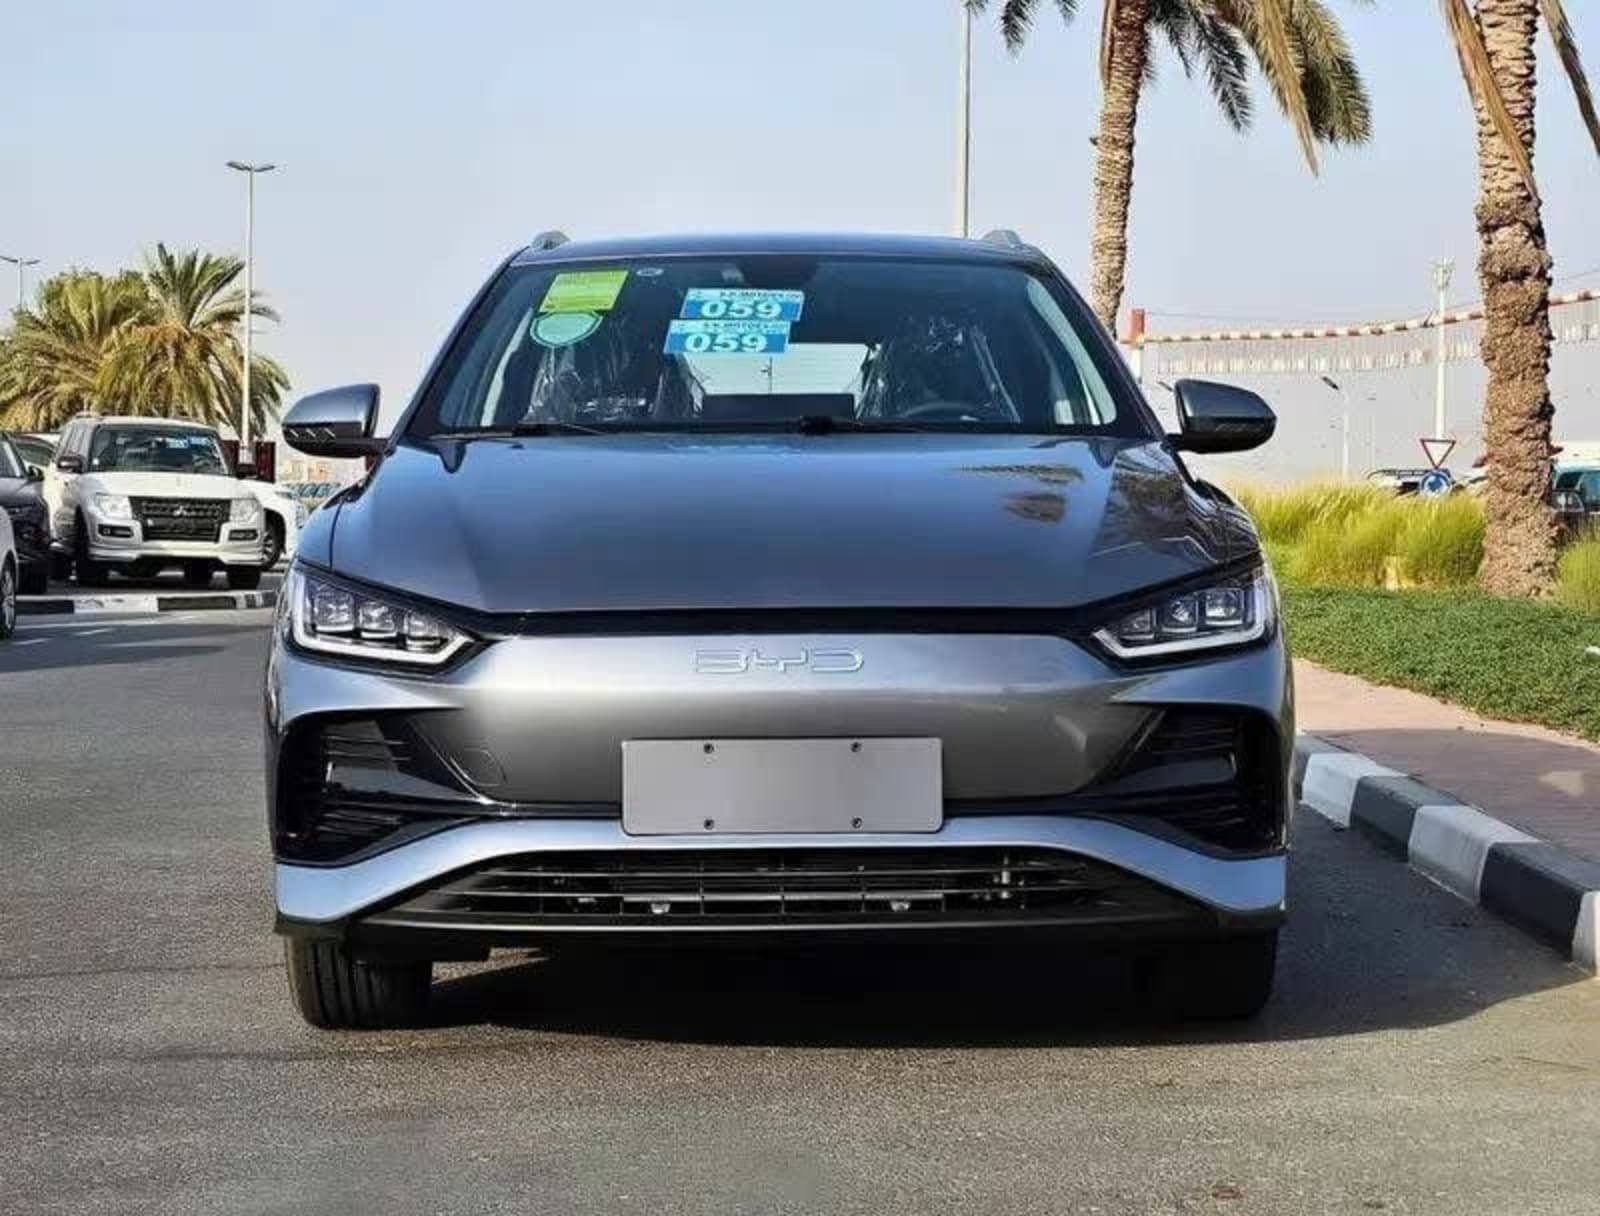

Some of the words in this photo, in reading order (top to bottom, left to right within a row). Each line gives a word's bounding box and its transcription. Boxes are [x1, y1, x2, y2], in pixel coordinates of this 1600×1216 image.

[701, 300, 782, 319] 059
[685, 333, 767, 353] 059
[694, 649, 866, 674] BYD
